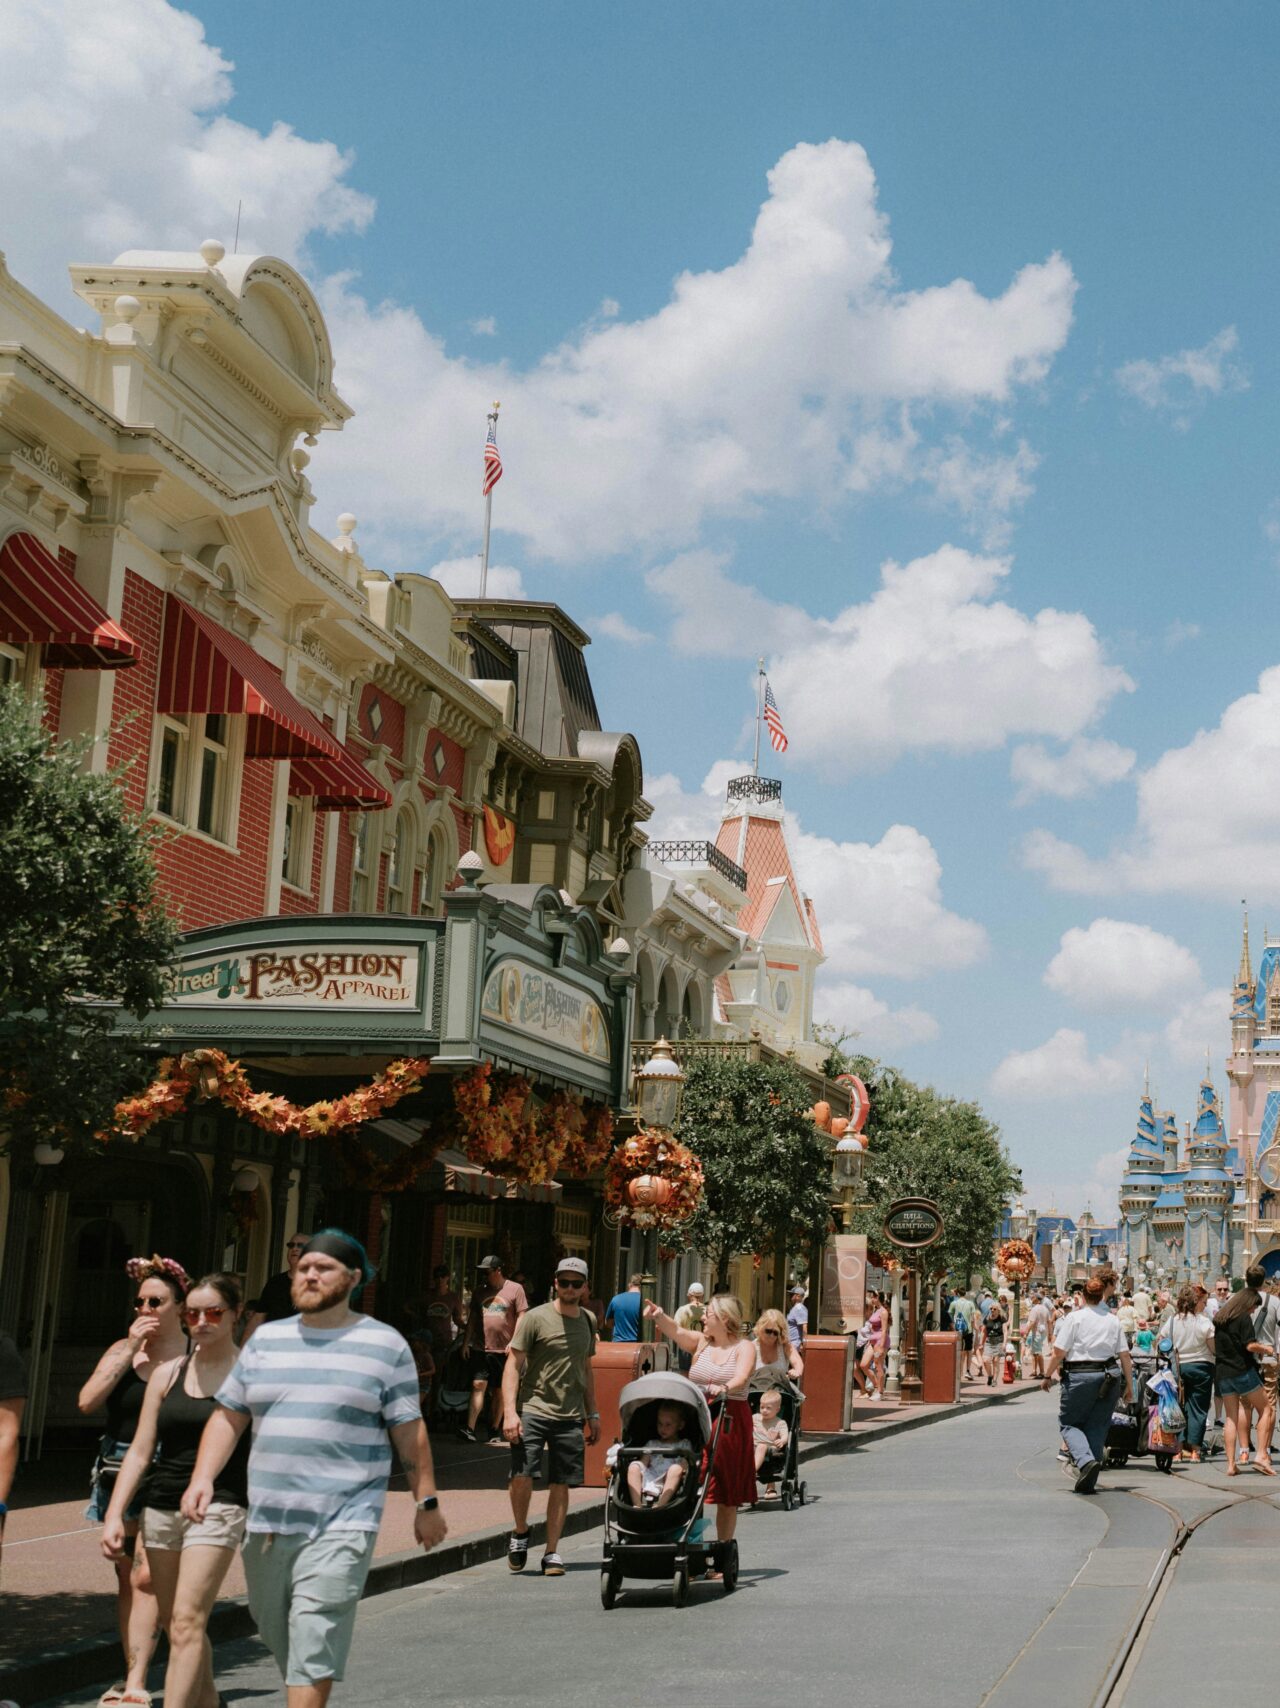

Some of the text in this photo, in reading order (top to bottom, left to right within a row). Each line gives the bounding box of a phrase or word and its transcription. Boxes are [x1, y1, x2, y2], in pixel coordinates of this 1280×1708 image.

[160, 952, 407, 1000] Street FASHION
[316, 979, 411, 1000] APPAREL
[891, 1222, 935, 1230] CHAMPIONS
[827, 1253, 862, 1291] 50
